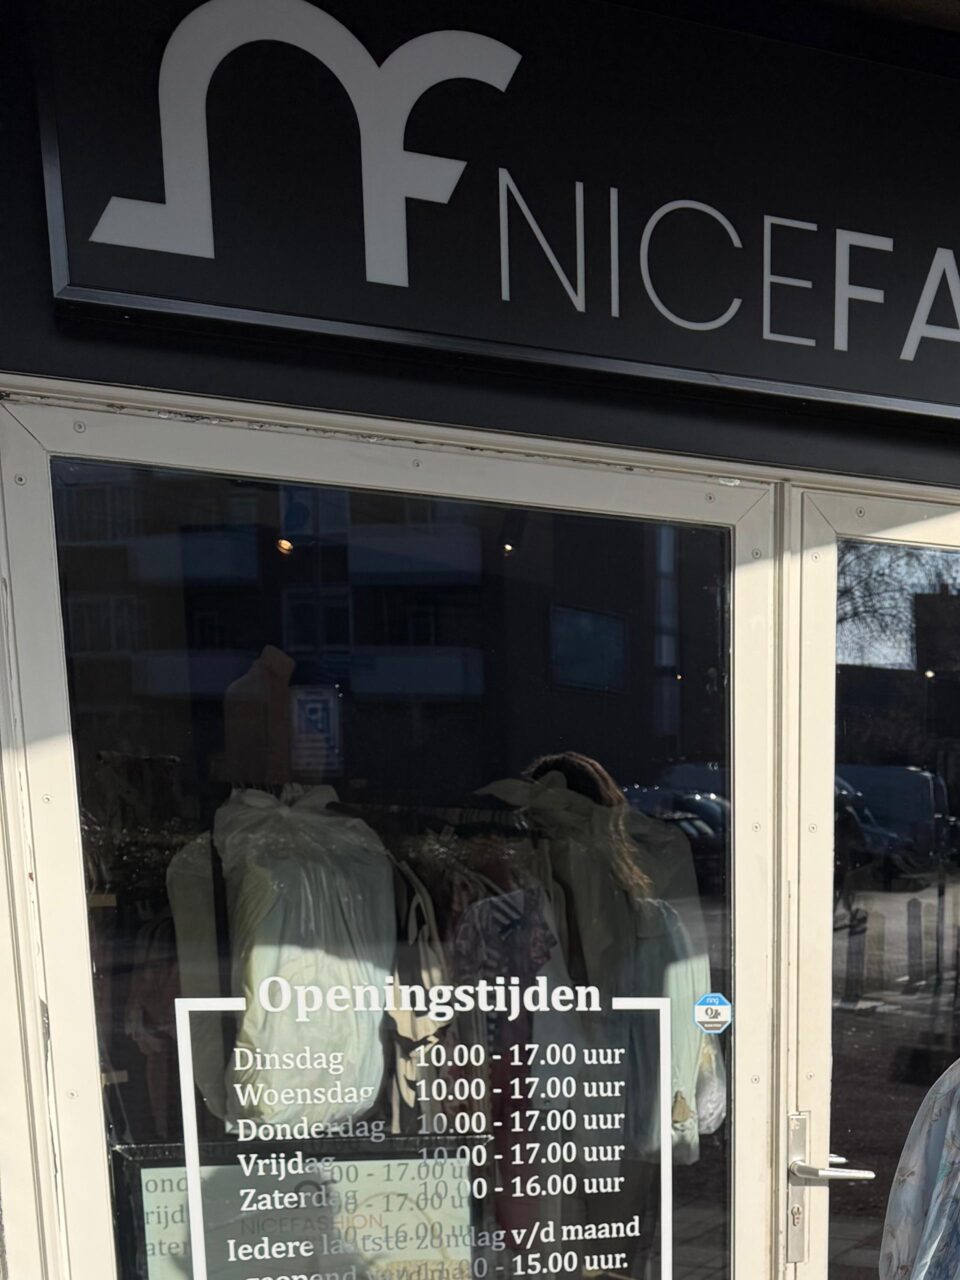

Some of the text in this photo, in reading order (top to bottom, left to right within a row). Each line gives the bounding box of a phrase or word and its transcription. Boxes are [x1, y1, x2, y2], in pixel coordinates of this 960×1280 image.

[258, 975, 602, 1022] Openingstijden
[233, 1046, 344, 1075] Dinsdag
[415, 1044, 485, 1067] 10.00
[509, 1043, 576, 1066] 17.00
[583, 1048, 625, 1064] uur
[233, 1081, 375, 1110] Woensdag
[415, 1078, 486, 1101] 10.00
[509, 1076, 577, 1099] 17.00
[583, 1081, 625, 1097] uur
[236, 1116, 385, 1142] Donderdag
[417, 1111, 486, 1135] 10.00
[510, 1109, 577, 1132] 17.00
[583, 1112, 625, 1130] uur
[237, 1151, 336, 1181] Vrijdag
[418, 1141, 487, 1167] 10.00
[511, 1141, 577, 1165] 17.00
[584, 1144, 625, 1162] uur
[511, 1173, 577, 1197] 16.00
[583, 1176, 625, 1194] uur
[227, 1236, 314, 1262] Iedere
[321, 1233, 409, 1256] latste
[511, 1221, 555, 1250] v/d
[561, 1215, 640, 1241] maand
[512, 1251, 578, 1276] 15.00
[585, 1252, 628, 1271] uur.
